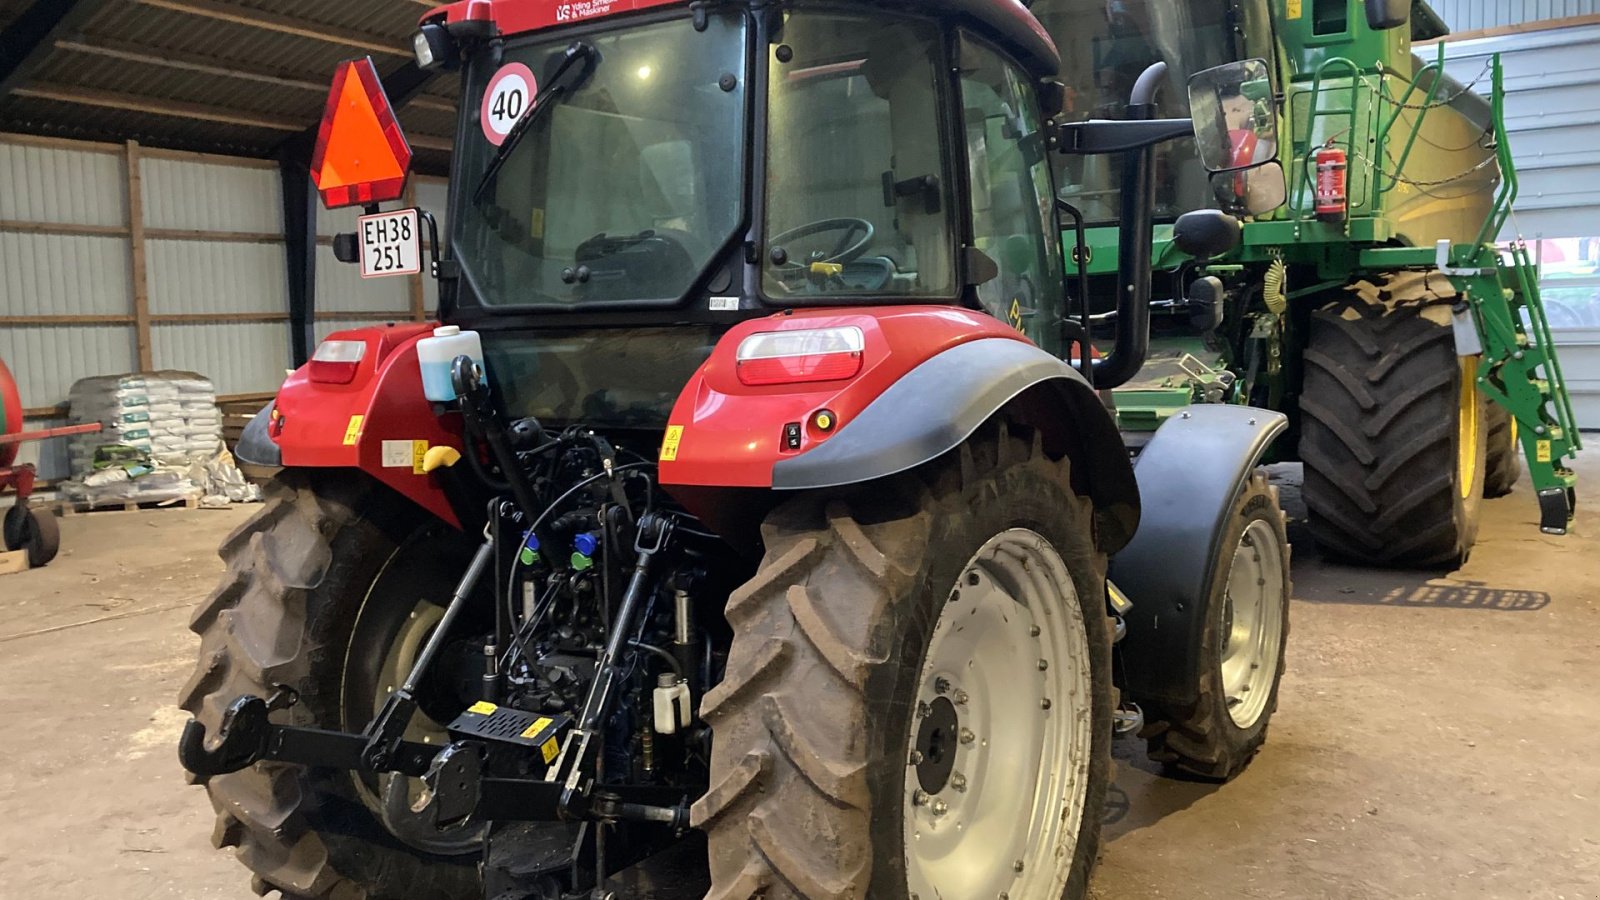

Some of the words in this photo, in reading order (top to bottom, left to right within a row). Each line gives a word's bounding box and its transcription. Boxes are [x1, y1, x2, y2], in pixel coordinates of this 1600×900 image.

[492, 89, 522, 121] 40
[365, 216, 411, 245] EH38
[373, 245, 404, 272] 251
